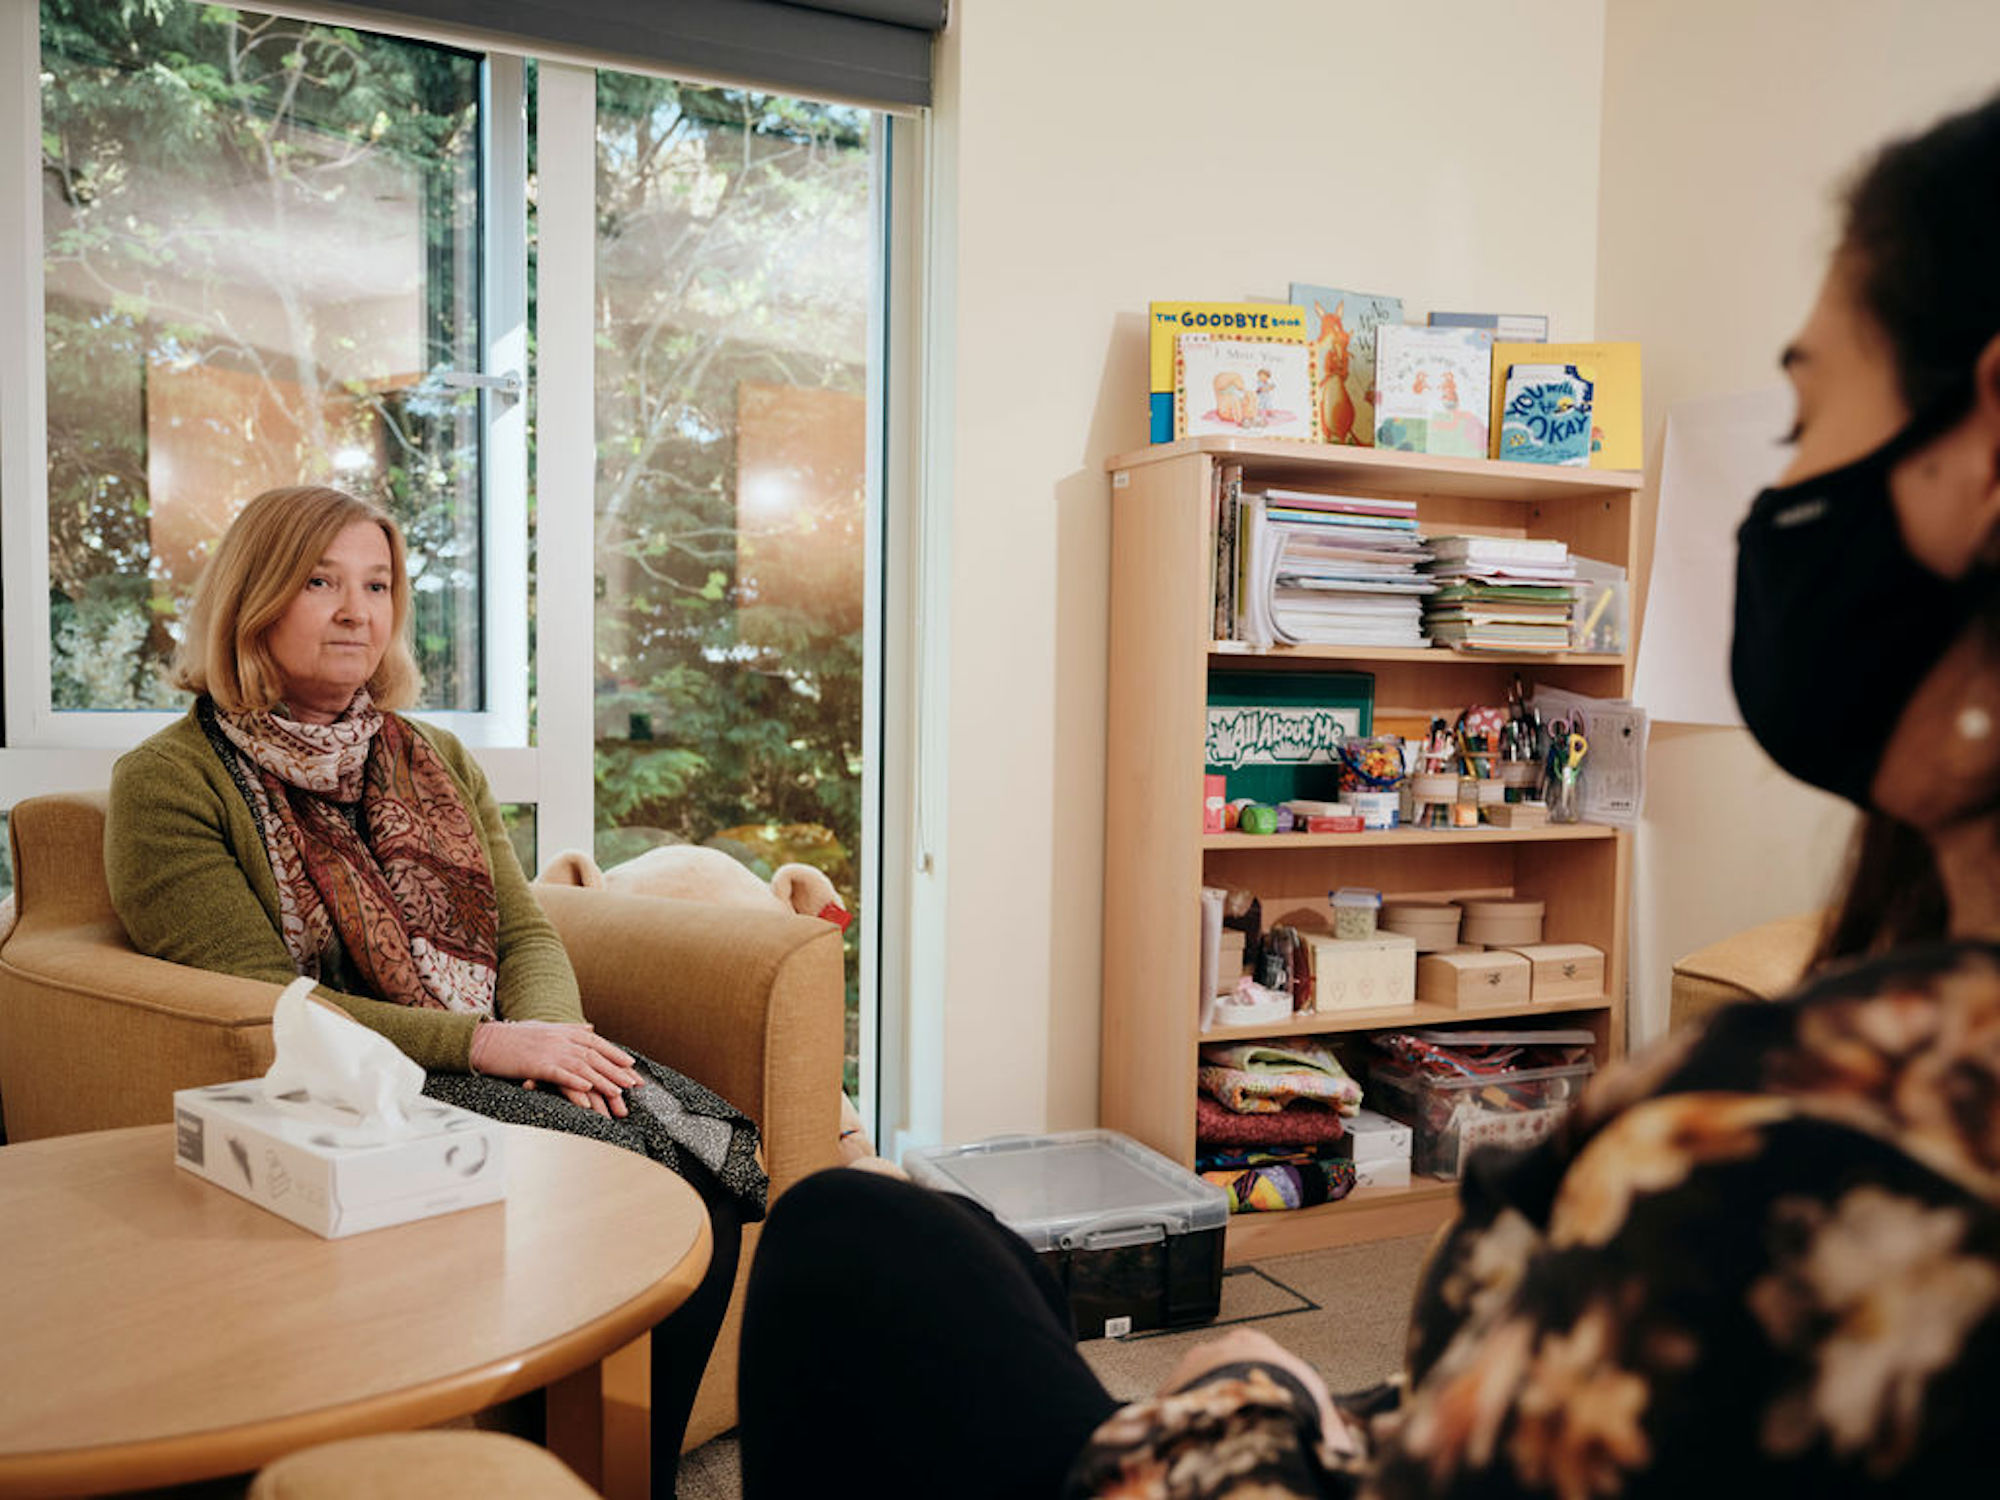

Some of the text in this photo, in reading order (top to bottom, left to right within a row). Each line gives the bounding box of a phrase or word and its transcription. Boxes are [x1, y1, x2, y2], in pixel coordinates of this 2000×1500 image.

[1156, 312, 1177, 322] THE
[1181, 311, 1269, 329] GOODBYE
[1505, 384, 1544, 416] YOU
[1526, 416, 1588, 444] OKAY
[1232, 711, 1345, 749] All About Me
